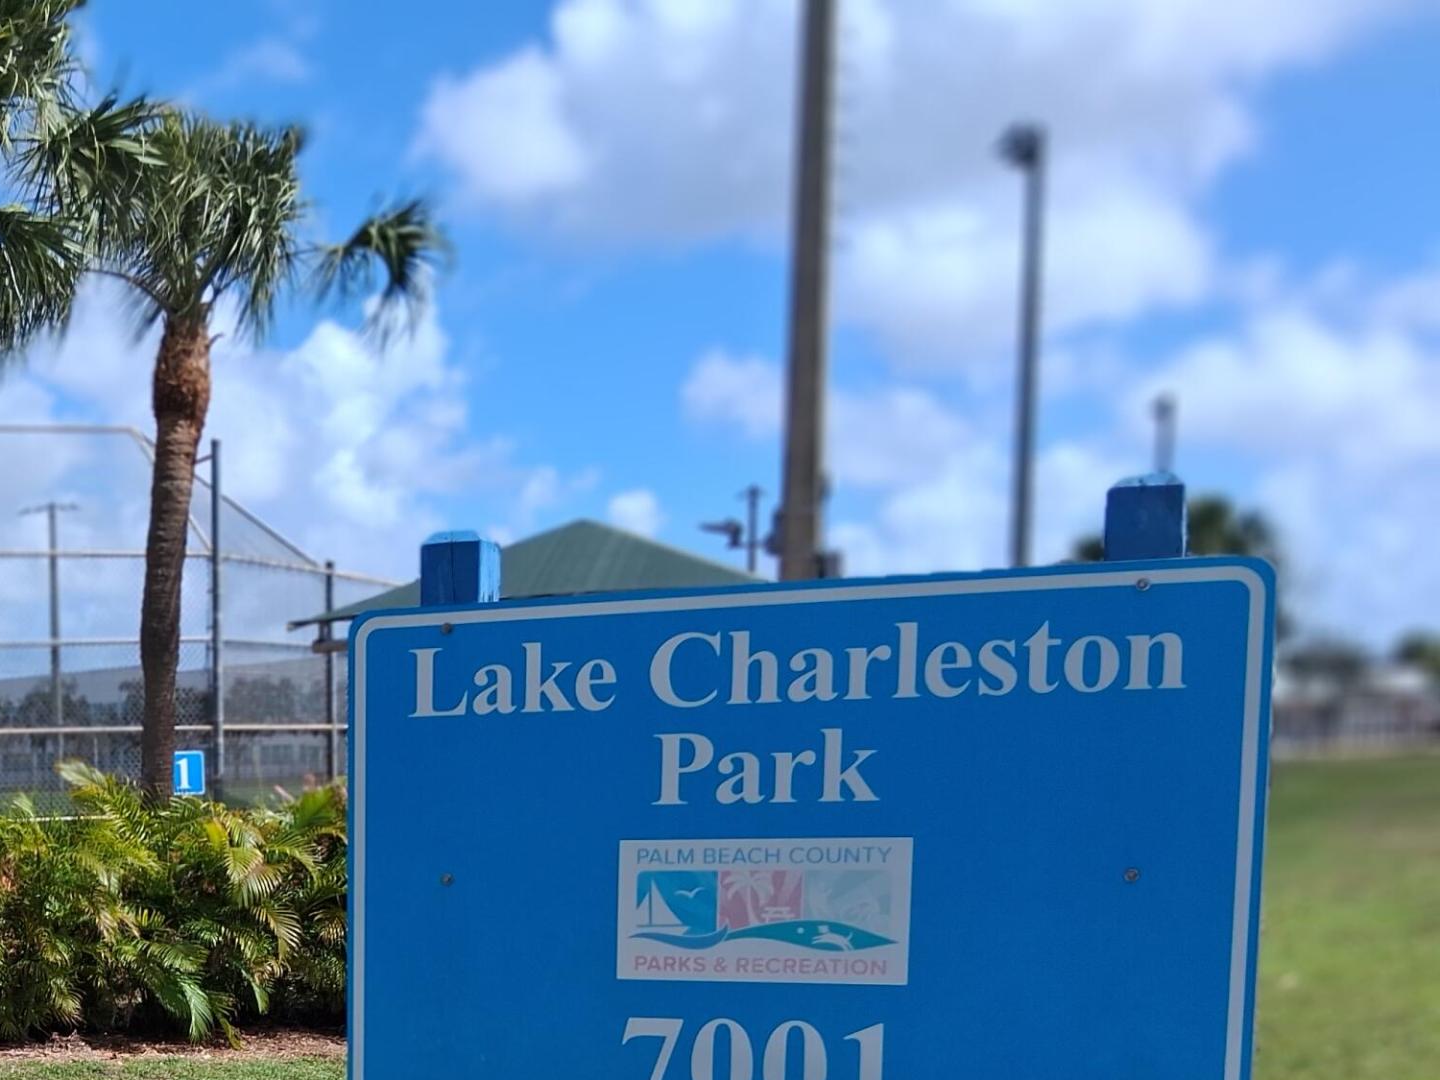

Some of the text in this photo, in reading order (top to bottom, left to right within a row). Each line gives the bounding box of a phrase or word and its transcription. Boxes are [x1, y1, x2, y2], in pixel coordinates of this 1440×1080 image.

[408, 621, 1187, 718] Lake Charleston
[176, 757, 191, 789] 1
[652, 728, 880, 806] Park
[636, 846, 893, 865] PALM BEACH COUNTY
[634, 955, 887, 976] PARKS & RECREATION
